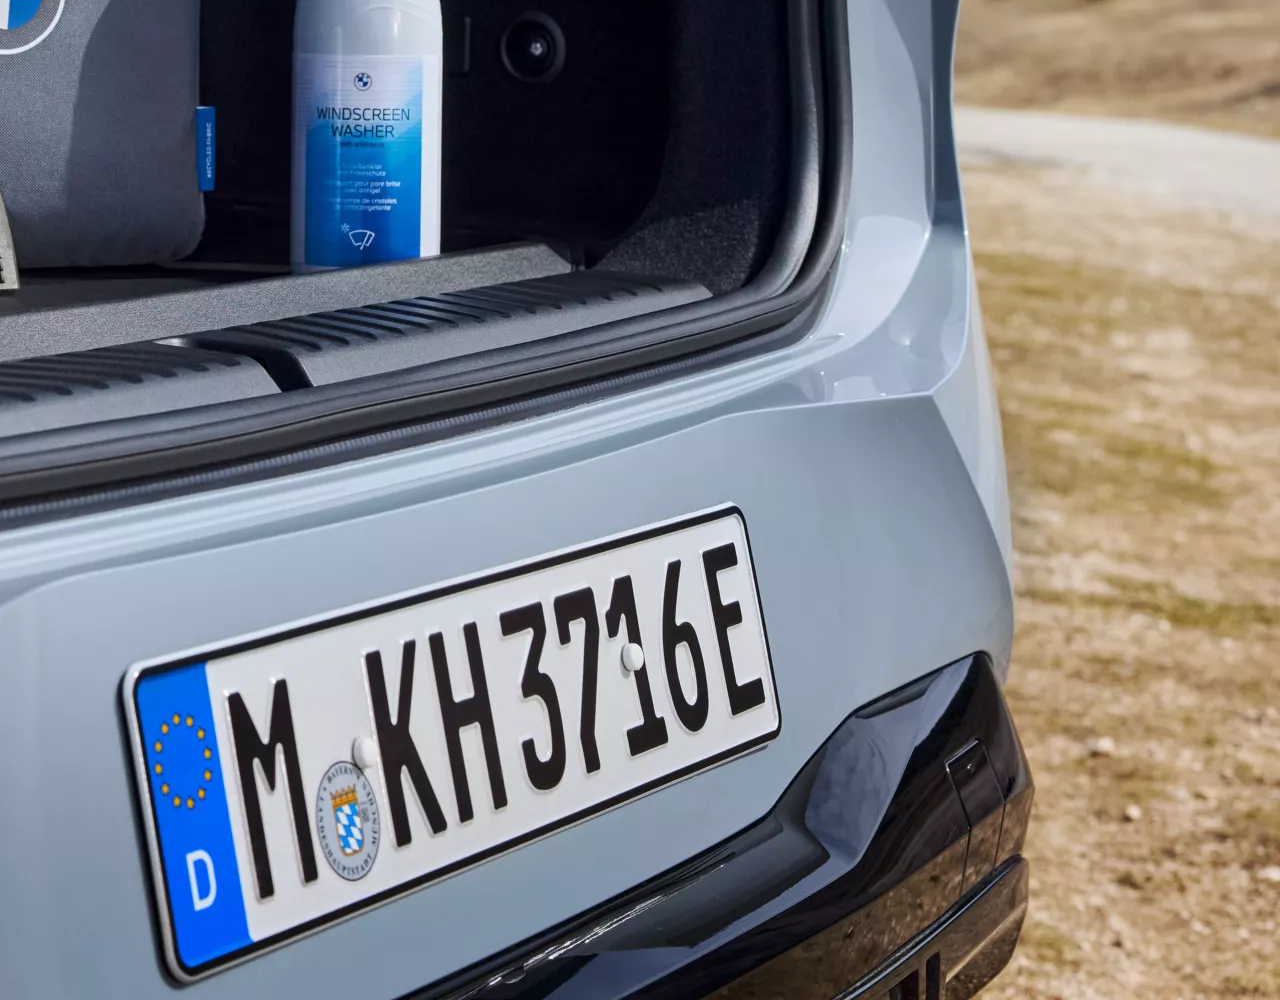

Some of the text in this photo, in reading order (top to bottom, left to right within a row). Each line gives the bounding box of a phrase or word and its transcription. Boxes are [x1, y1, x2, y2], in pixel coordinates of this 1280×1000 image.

[317, 107, 410, 121] WINDSCREEN
[331, 124, 395, 138] WASHER
[227, 678, 318, 901] M
[185, 849, 216, 911] D
